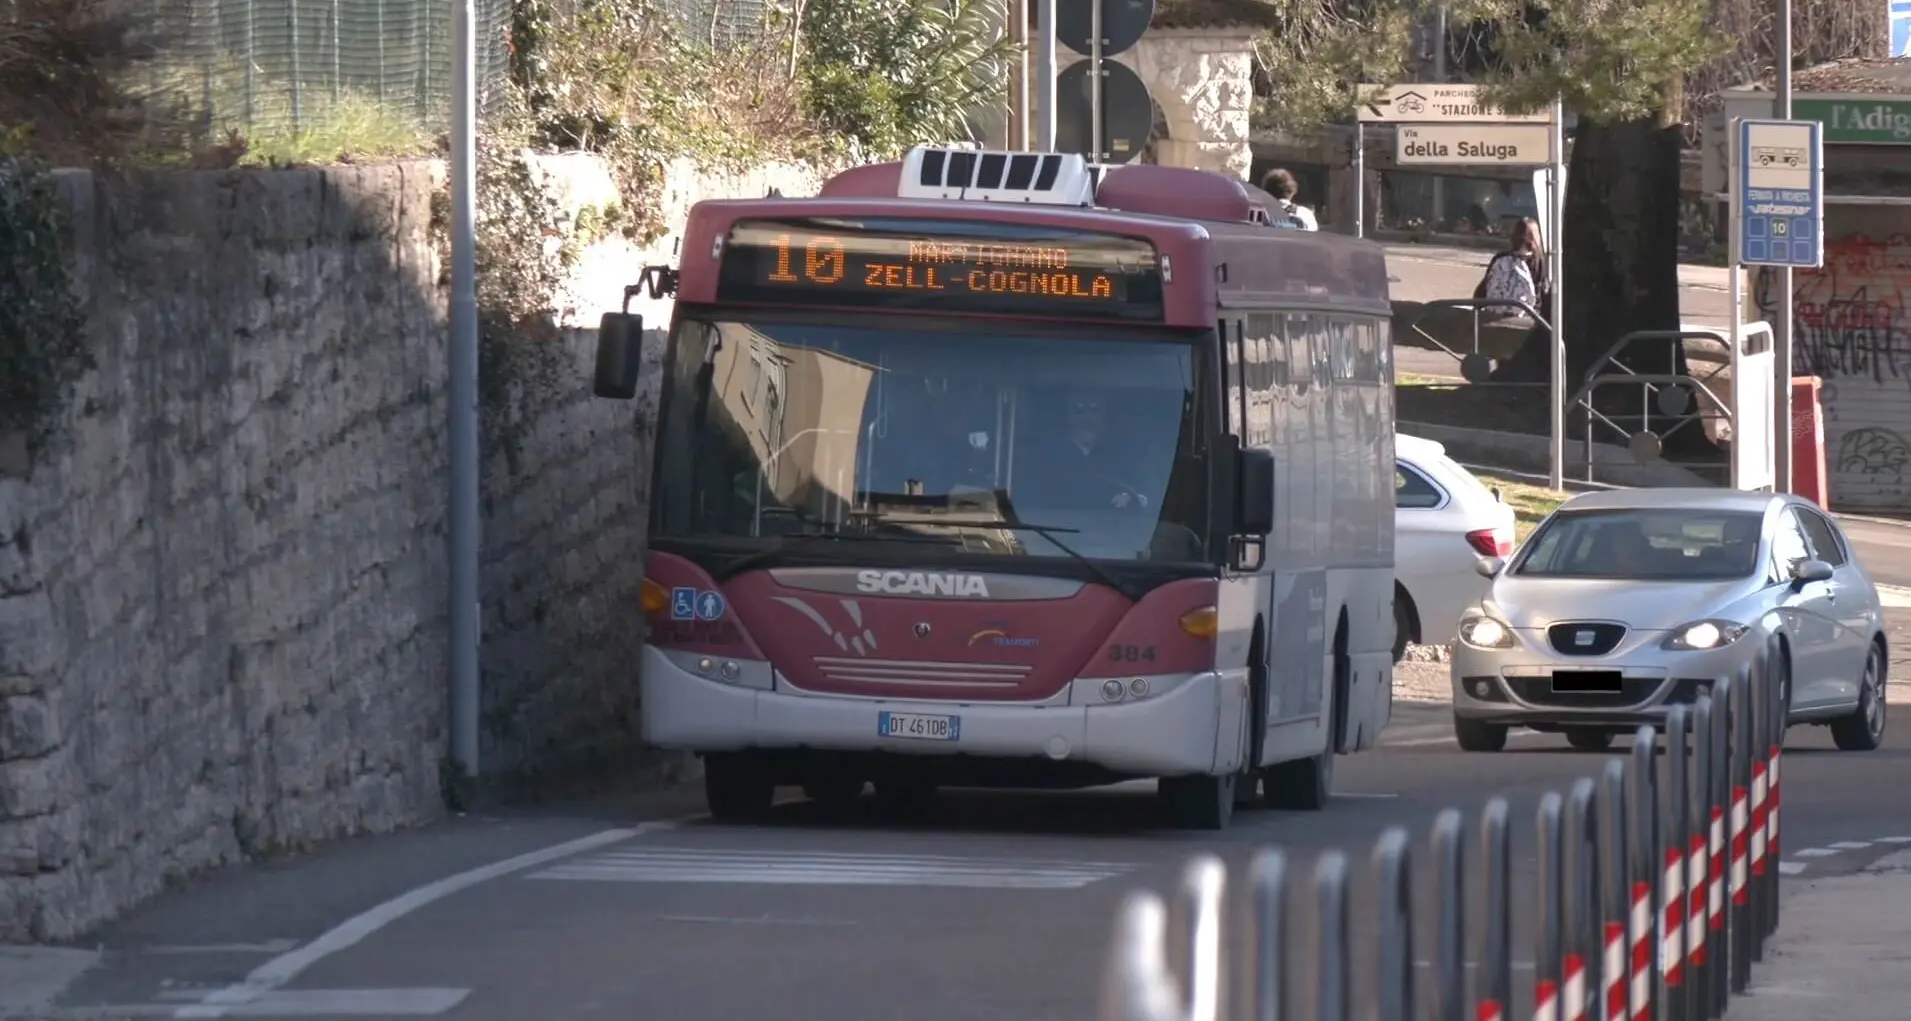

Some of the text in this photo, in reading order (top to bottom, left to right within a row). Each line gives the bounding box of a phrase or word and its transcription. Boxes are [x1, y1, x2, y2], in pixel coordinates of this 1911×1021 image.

[1404, 129, 1418, 137] Via
[1404, 141, 1517, 160] della Saluga
[1772, 222, 1786, 234] 10
[767, 233, 845, 284] 10
[909, 240, 1068, 270] MARTIGNANO
[864, 263, 1112, 297] ZELL-COGNOLA
[856, 570, 990, 598] SCANIA
[1107, 644, 1156, 662] 384
